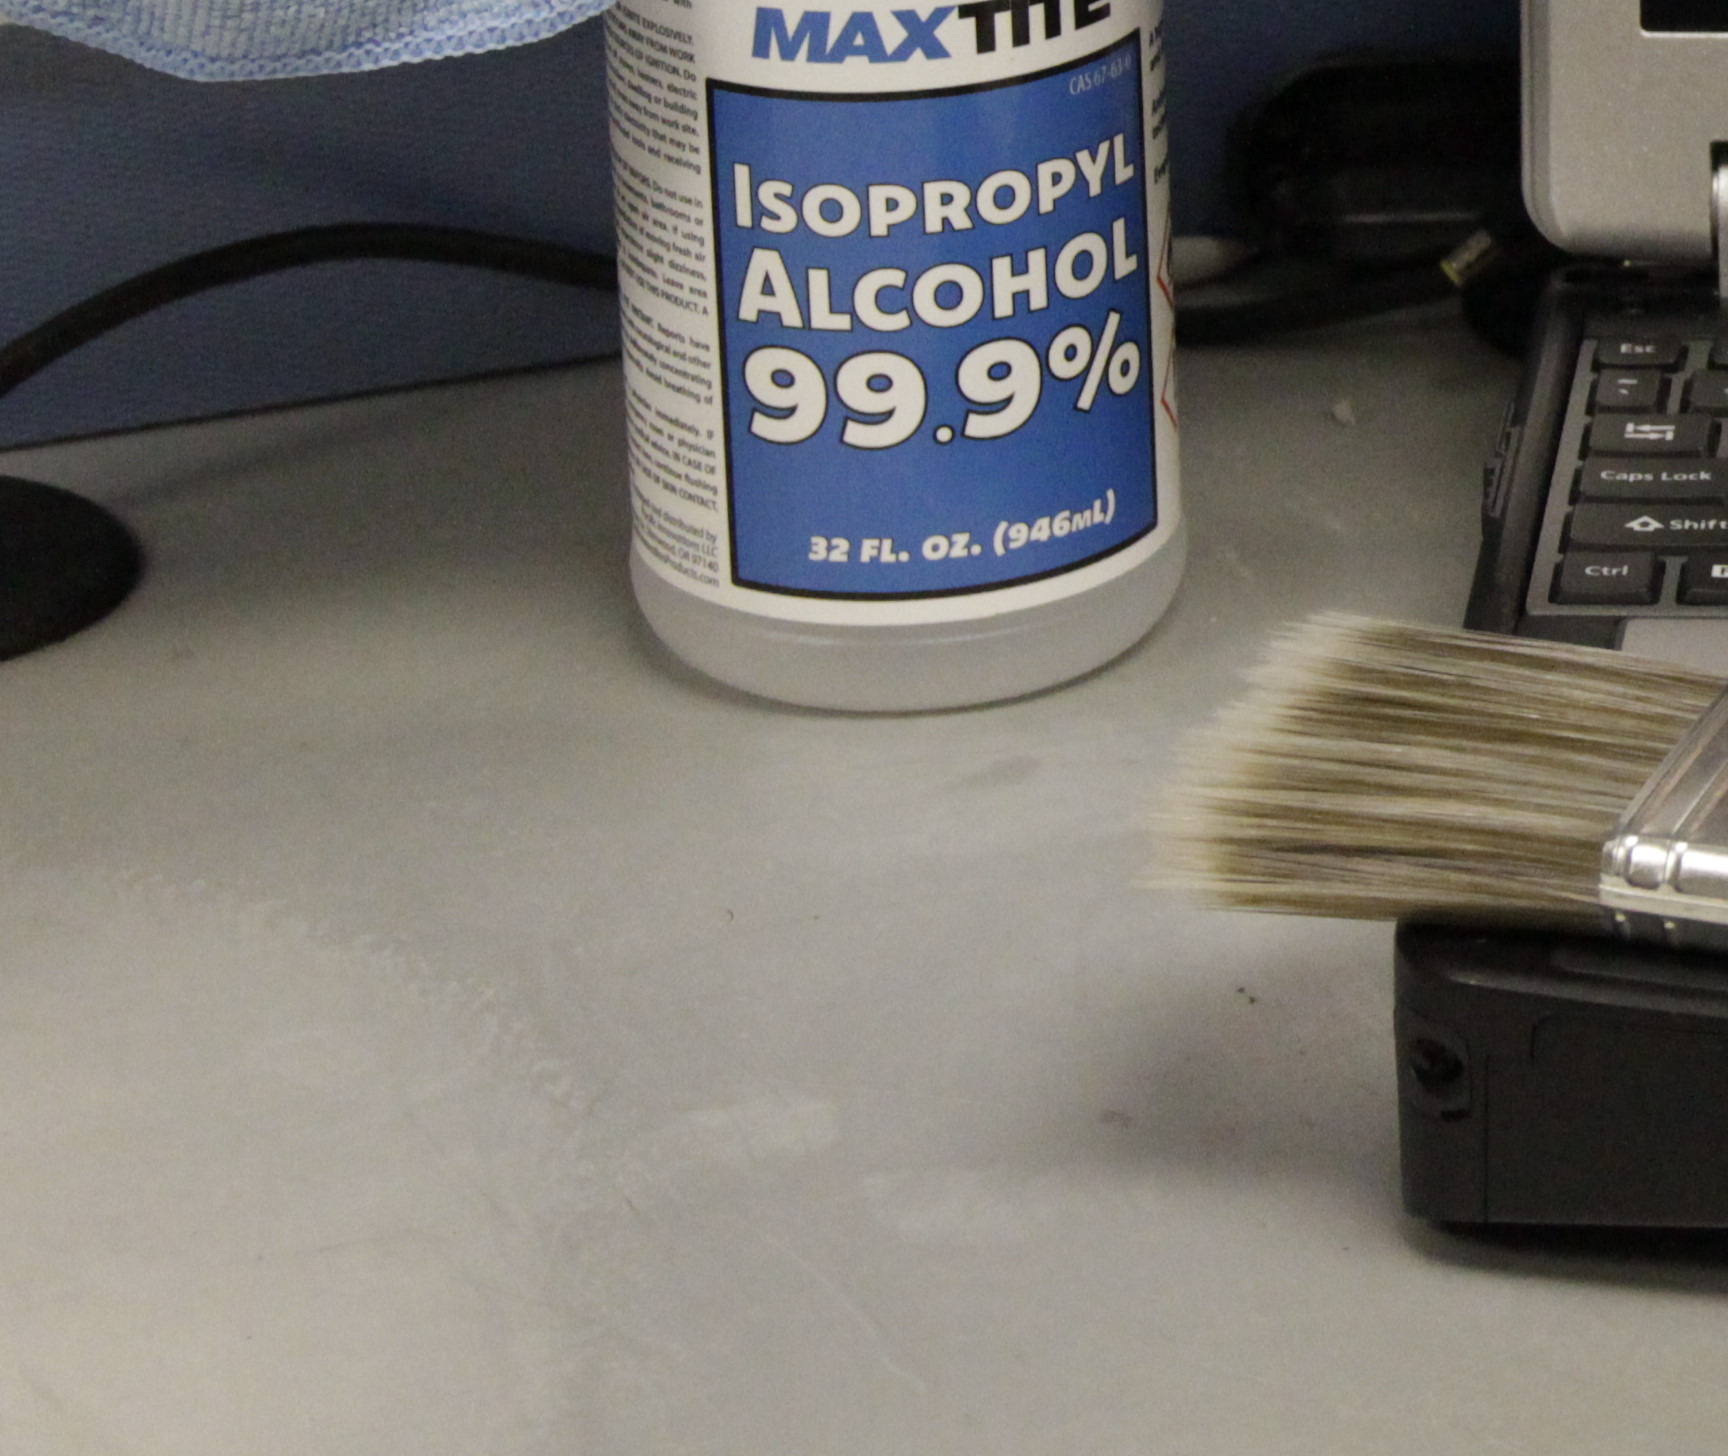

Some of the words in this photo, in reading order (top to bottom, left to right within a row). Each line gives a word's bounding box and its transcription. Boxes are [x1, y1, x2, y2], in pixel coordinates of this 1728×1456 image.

[732, 133, 1136, 239] ISOPROPYL
[736, 216, 1139, 332] ALCOHOL
[1620, 344, 1652, 353] Esc
[742, 308, 1141, 450] 99.9%
[1601, 470, 1653, 483] Caps
[1661, 470, 1712, 481] Lock
[1670, 520, 1727, 529] Shift
[808, 536, 850, 563] 32
[860, 538, 910, 563] FL.
[922, 531, 982, 561] OZ.
[1585, 565, 1628, 575] Ctrl
